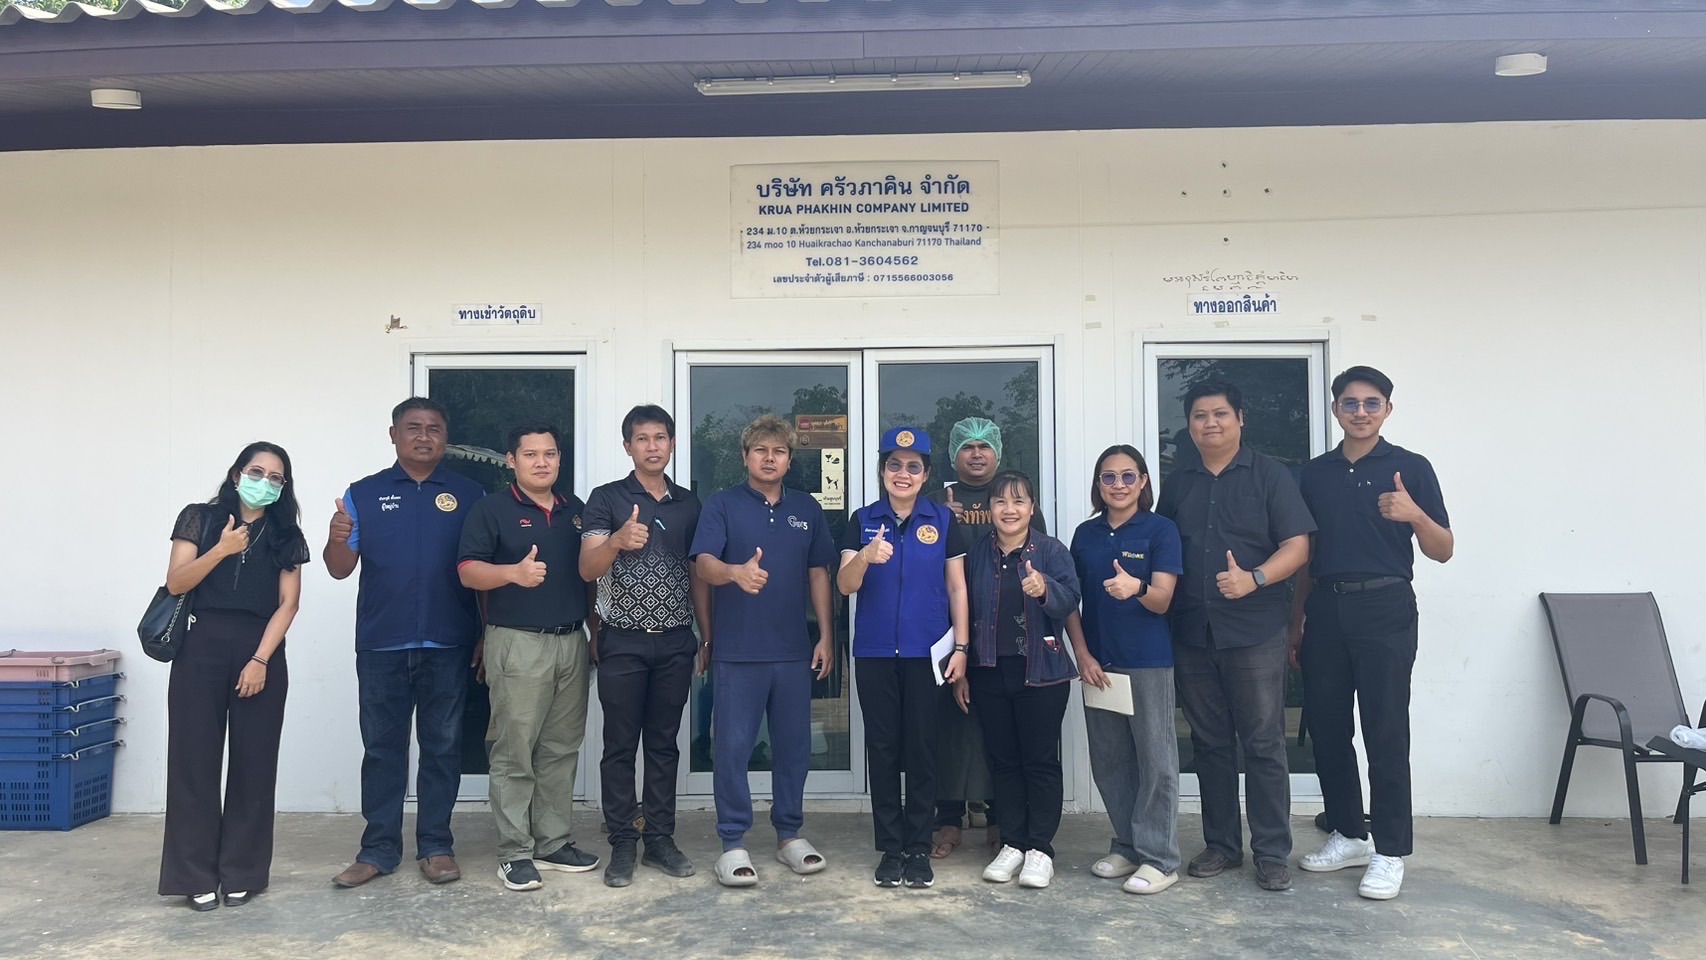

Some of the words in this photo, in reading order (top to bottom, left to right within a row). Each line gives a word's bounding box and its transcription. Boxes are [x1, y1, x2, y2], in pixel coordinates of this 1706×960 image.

[756, 177, 812, 198] บริษัท
[821, 175, 912, 196] ครัวภาคิน
[920, 174, 970, 194] จำกัด
[759, 205, 792, 215] KRUA
[797, 204, 851, 214] PHAKHIN
[856, 203, 916, 213] COMPANY
[921, 202, 969, 212] LIMITED
[747, 227, 764, 235] 234
[767, 227, 787, 235] ม.10
[790, 224, 843, 234] ต.ห้วยกระเจา
[846, 224, 899, 233] อ.ห้วยกระเจา
[902, 221, 950, 236] จ.กาญจนบุรี
[953, 224, 983, 232] 71170
[747, 241, 761, 249] 234
[787, 240, 796, 248] 10
[799, 239, 852, 248] Huaikrachao
[855, 238, 914, 247] Kanchanaburi
[917, 238, 942, 246] 71170
[945, 237, 981, 246] Thailand
[806, 256, 918, 266] Tel.081-3604562
[773, 272, 864, 285] เลขประจำตัวผู้เสียภาษี
[1194, 293, 1276, 313] ทางออกสินค้า
[458, 305, 535, 324] ทางเข้าวัตถุดิบ
